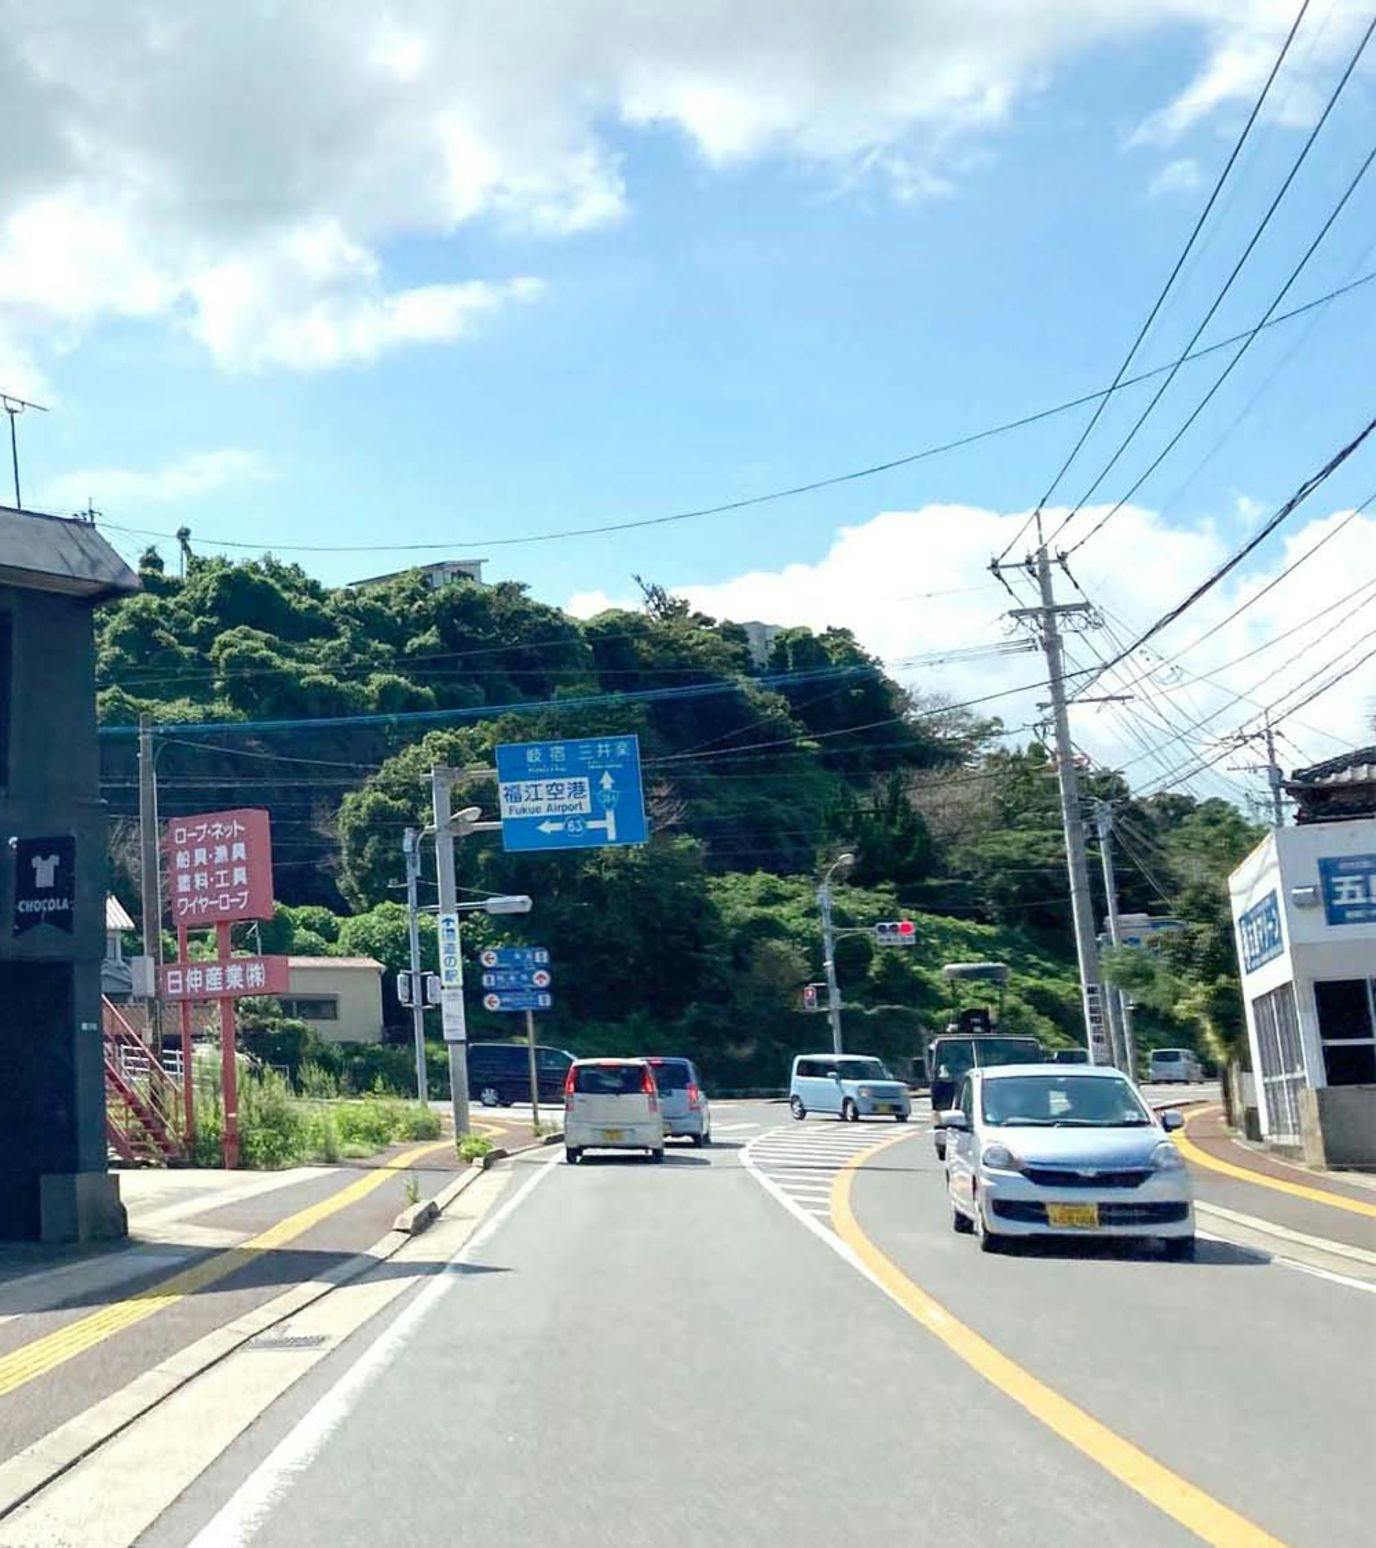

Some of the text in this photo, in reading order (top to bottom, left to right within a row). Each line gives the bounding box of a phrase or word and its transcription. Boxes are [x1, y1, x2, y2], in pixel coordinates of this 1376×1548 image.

[503, 780, 587, 803] 福江空港
[509, 801, 583, 816] Fukue Airport
[17, 897, 69, 913] CHOCOLA
[177, 891, 249, 916] ワイヤーロープ
